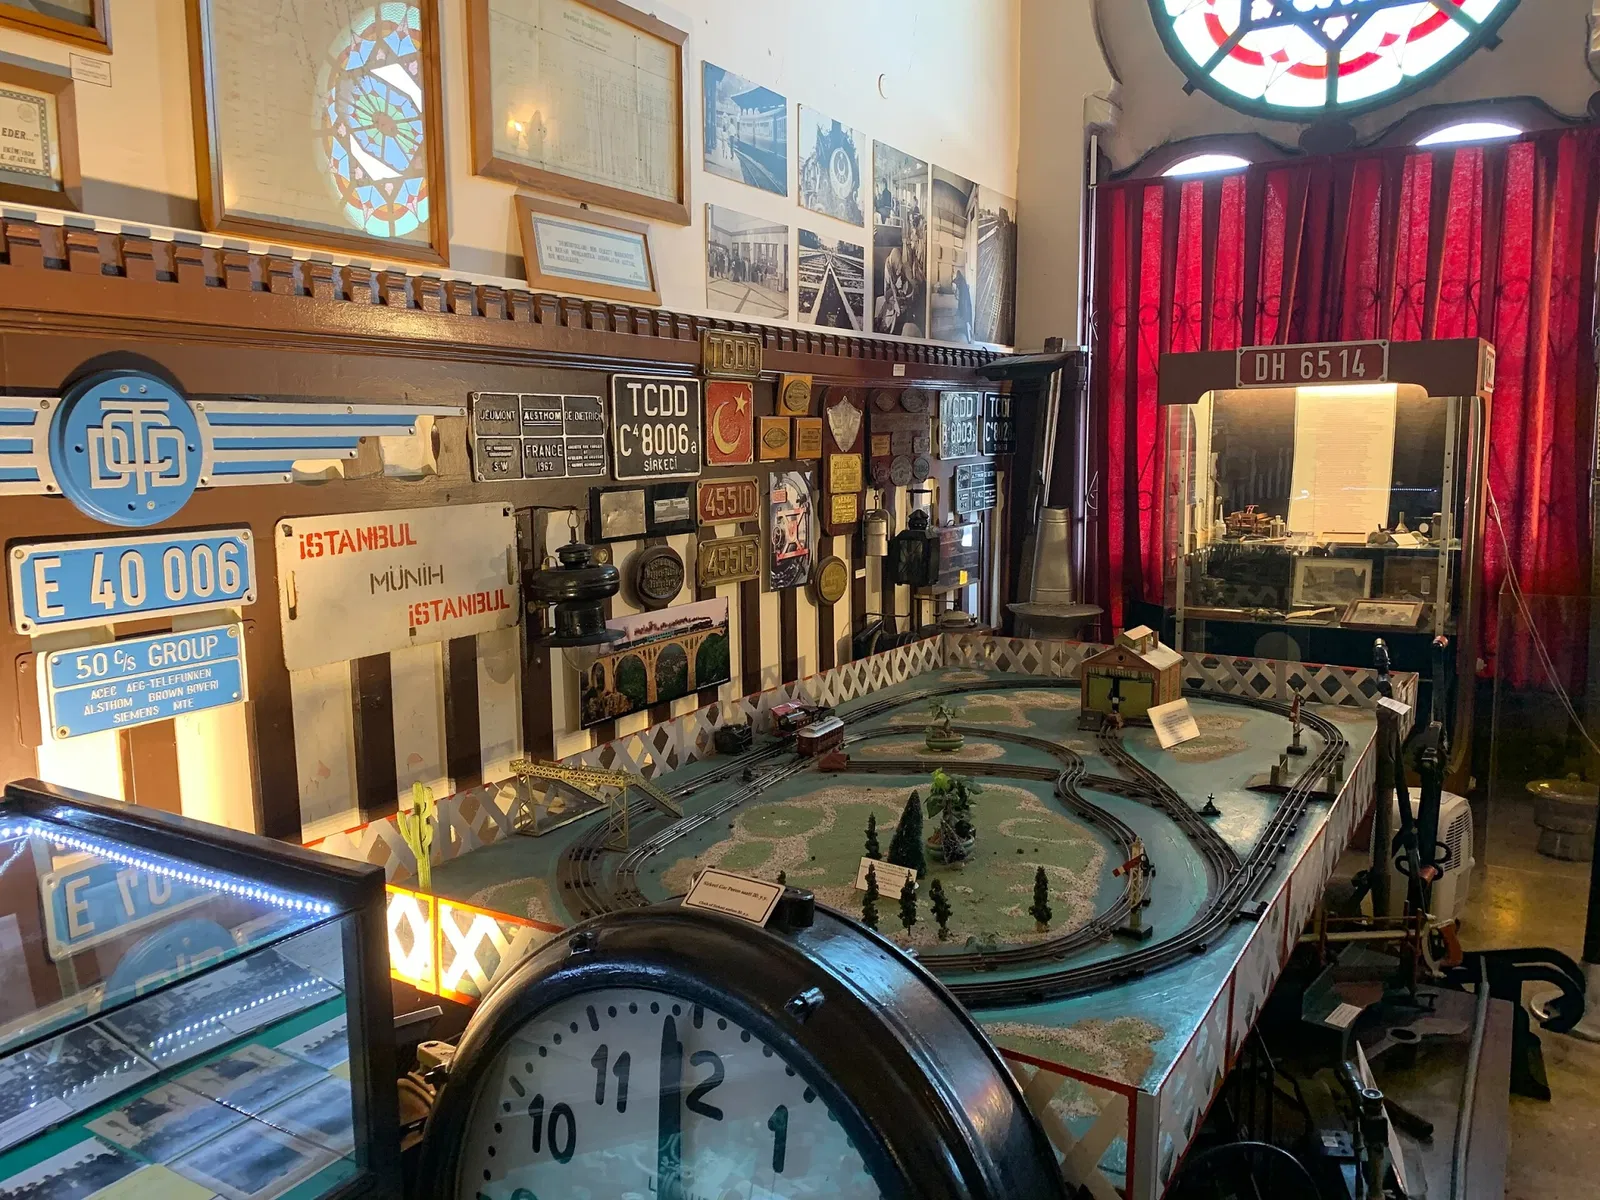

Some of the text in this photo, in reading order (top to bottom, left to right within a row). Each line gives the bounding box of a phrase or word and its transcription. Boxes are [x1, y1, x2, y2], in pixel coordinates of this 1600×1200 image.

[1255, 349, 1366, 381] DH 6514
[523, 410, 562, 421] ALSTHOM
[626, 382, 688, 417] TCDD
[525, 444, 563, 457] FRANCE
[536, 461, 554, 472] 1962
[705, 485, 753, 517] 45510
[707, 544, 755, 577] 45515
[33, 541, 241, 618] E 40 006
[369, 562, 444, 595] MÜNİH
[76, 652, 108, 679] 50
[148, 635, 219, 667] GROUP
[83, 680, 219, 716] ALSTHOM BROWN BOVERI
[91, 668, 212, 700] ACEC AEG-TELEFUNKEN
[112, 698, 194, 723] SIEMENS MTE
[591, 1043, 631, 1114] 11
[528, 1093, 577, 1165] 10
[767, 1104, 789, 1174] 1
